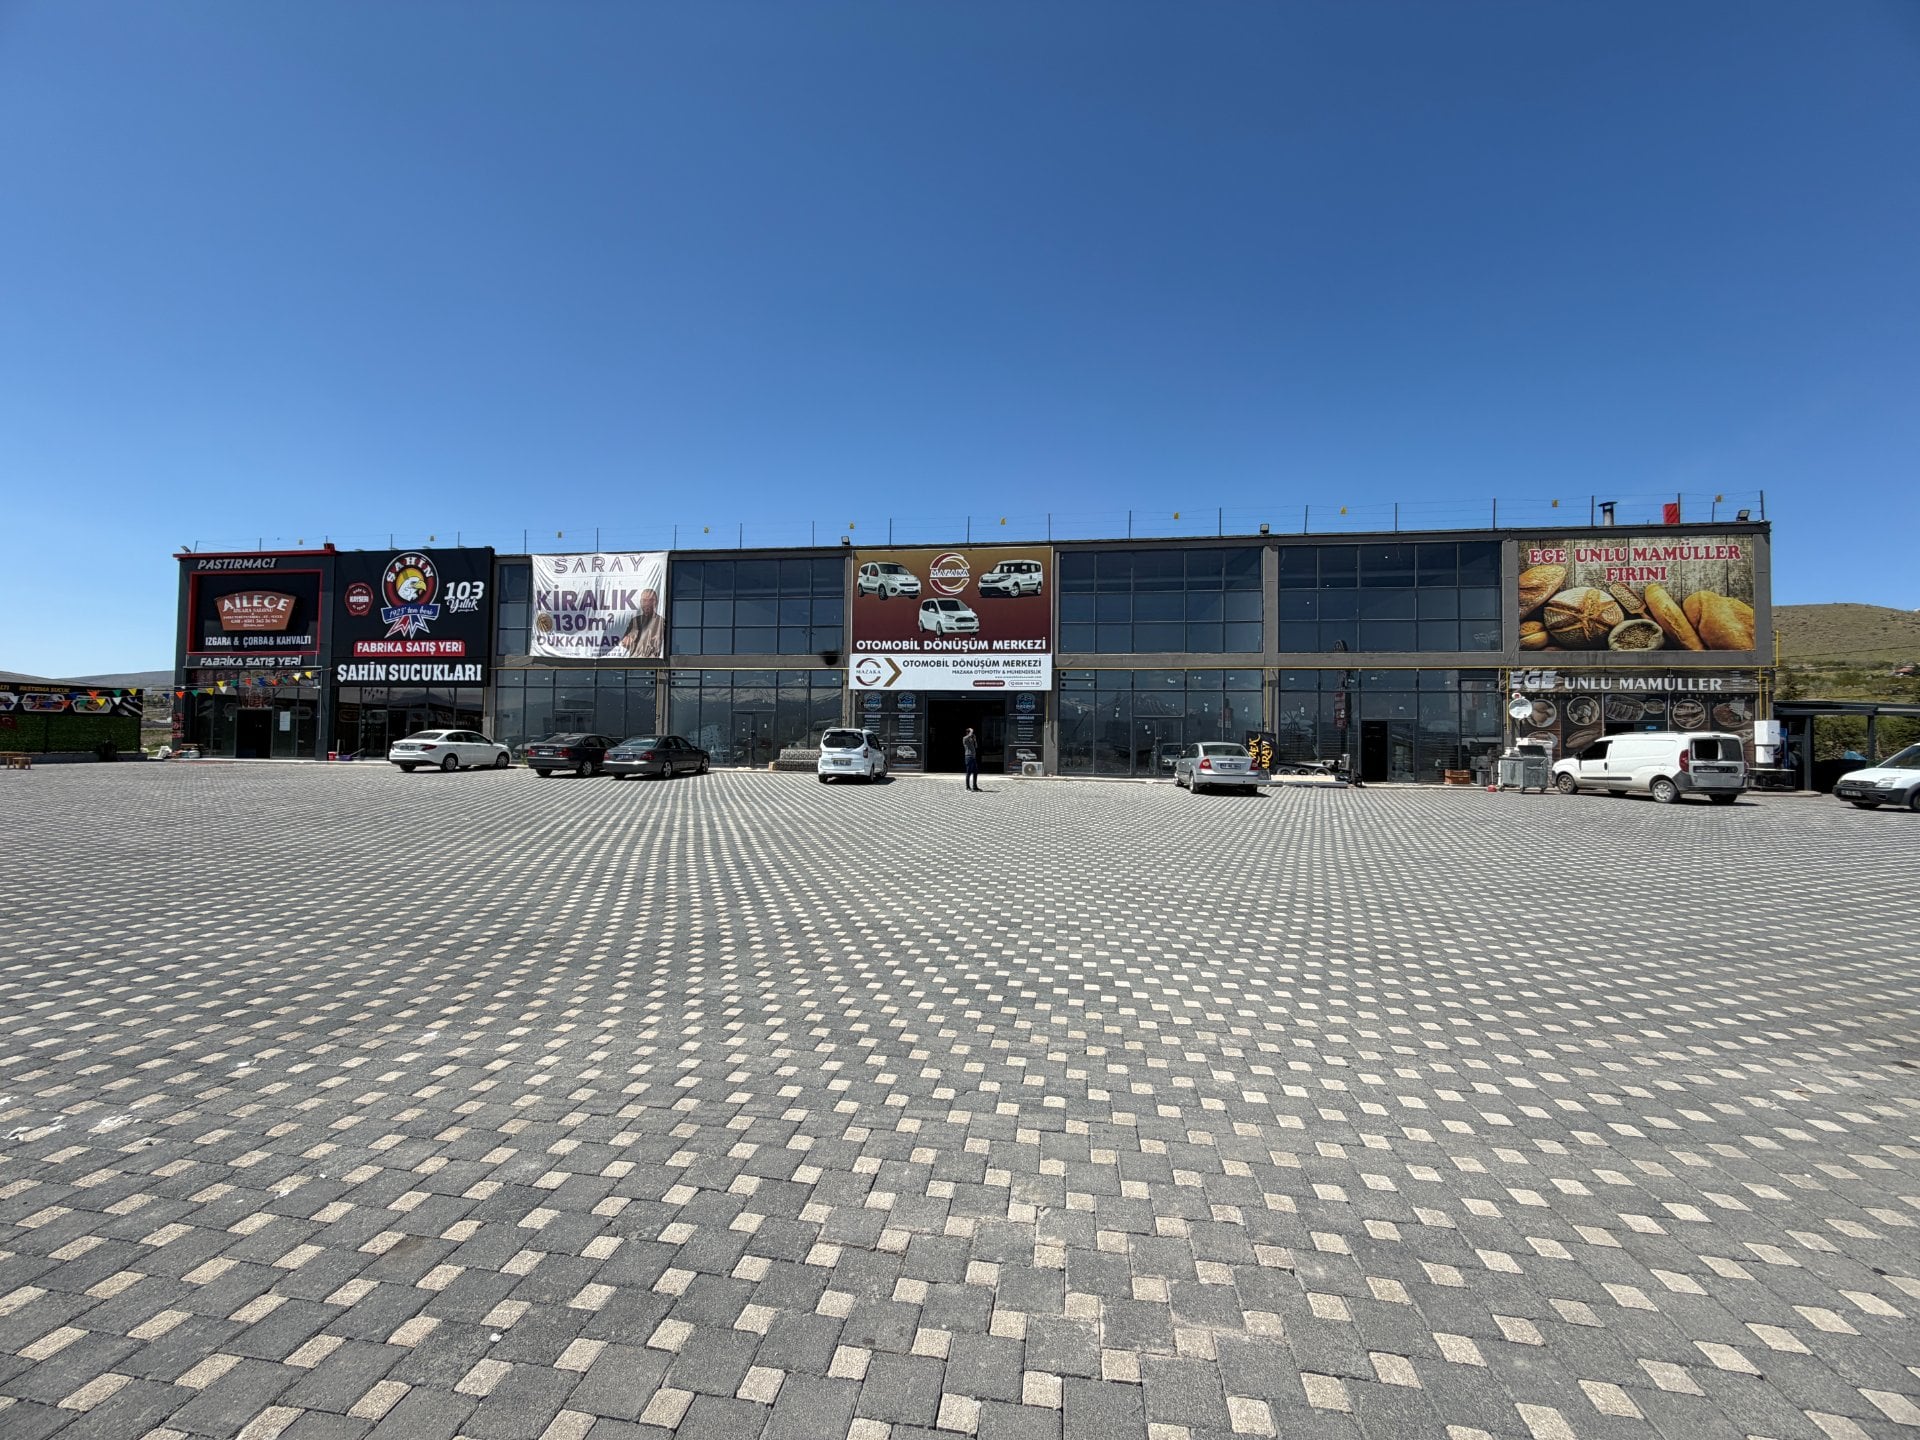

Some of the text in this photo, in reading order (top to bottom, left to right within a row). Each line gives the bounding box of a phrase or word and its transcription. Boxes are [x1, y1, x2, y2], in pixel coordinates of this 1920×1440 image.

[1529, 542, 1741, 564] EGE UNLU MAMÜLLER
[197, 558, 277, 569] PASTIRMACI
[554, 556, 645, 574] SARAY
[1605, 566, 1667, 582] FIRINI
[444, 581, 485, 600] 103
[537, 585, 638, 611] KİRALIK
[205, 636, 232, 646] IZGARA
[233, 637, 239, 646] &
[276, 635, 312, 645] KAHVALTI
[537, 632, 621, 647] DÜKKANLAR
[856, 637, 1046, 652] OTOMOBİL DÖNÜŞÜM MERKEZİ
[357, 642, 462, 655] FABRİKA SATIŞ YERİ
[200, 655, 244, 666] FABRİKA
[277, 654, 302, 666] YERİ
[902, 658, 1042, 670] OTOMOBİL DÖNÜŞÜM MERKEZİ
[337, 662, 482, 683] ŞAHİN SUCUKLARI
[1509, 671, 1723, 691] EGE UNLU MAMÜLLER
